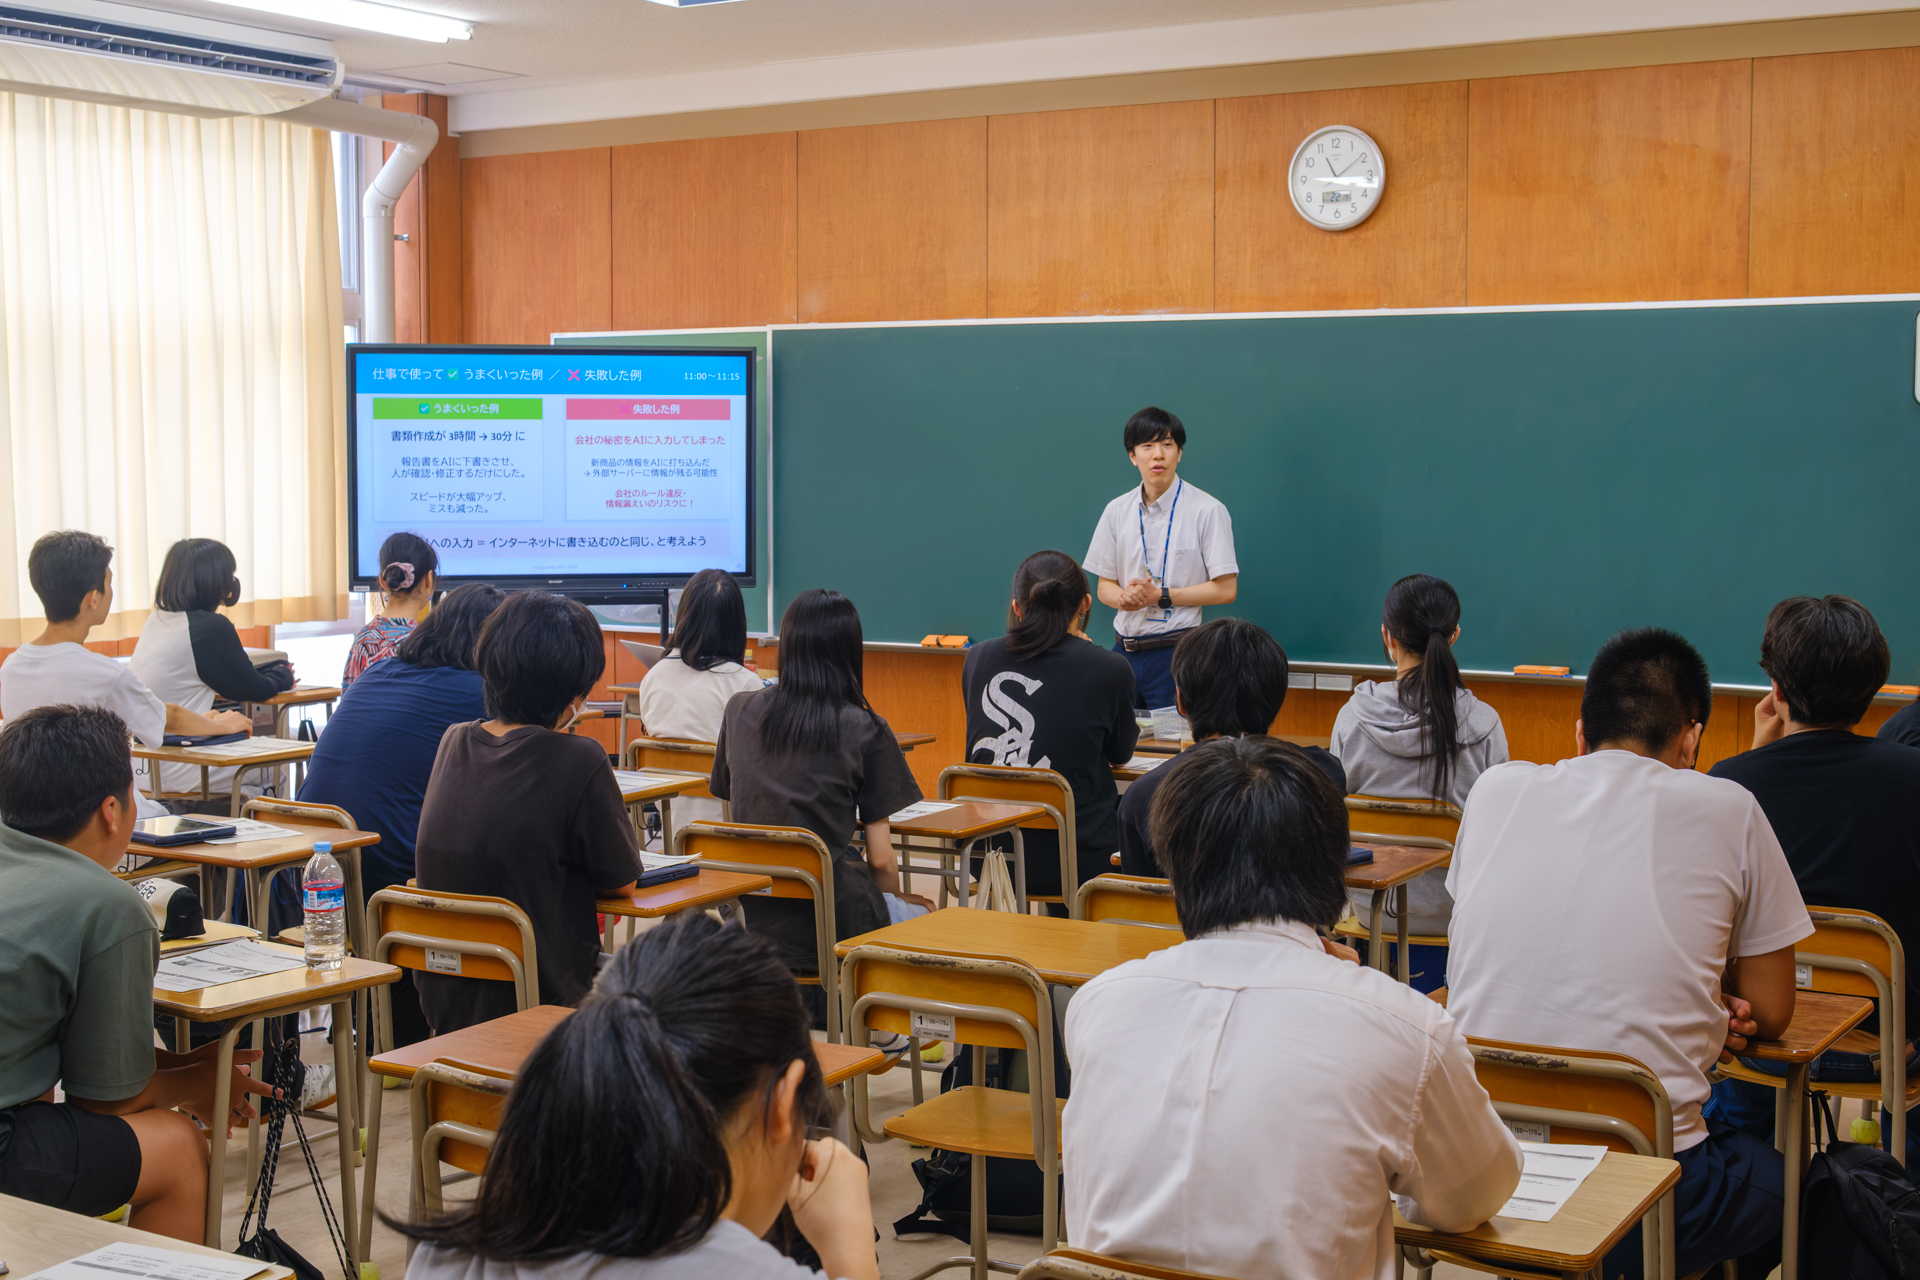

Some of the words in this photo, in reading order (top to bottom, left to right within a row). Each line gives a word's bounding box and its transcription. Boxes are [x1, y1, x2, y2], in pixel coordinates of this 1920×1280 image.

[1317, 143, 1324, 154] 11
[1331, 138, 1340, 149] 12
[1305, 157, 1315, 168] 10
[1360, 152, 1367, 163] 2
[1300, 175, 1307, 186] 9
[1366, 170, 1374, 181] 3
[1306, 192, 1312, 203] 8
[1330, 192, 1341, 203] 22
[1361, 188, 1368, 198] 4
[1318, 205, 1325, 215] 7
[1334, 208, 1341, 219] 6
[1350, 203, 1357, 213] 5
[372, 367, 444, 380] 仕事で使って
[464, 368, 543, 381] うまくいった例
[584, 369, 642, 382] 失敗した例
[433, 403, 499, 414] うまくいった例
[632, 404, 680, 415] 失敗した例
[391, 430, 446, 442] 書類作成が
[449, 431, 476, 442] 3時間
[491, 431, 513, 442] 30分
[515, 431, 526, 441] に
[575, 435, 726, 446] 会社の秘密をAIに入力してしまった
[401, 456, 514, 467] 報告書をAIに下書きさせ、
[591, 458, 710, 468] 新商品の情報をAIに打ち込んだ
[391, 468, 525, 479] 人が確認・修正するだけにした。
[592, 468, 718, 478] 外部サーバーに情報が残る可能性
[410, 491, 506, 502] スピードが大幅アップ、
[429, 503, 489, 514] ミスも減った。
[489, 536, 707, 549] インターネットに書き込むのと同じ、と考えよう
[431, 951, 435, 960] 1
[918, 1015, 923, 1025] 1
